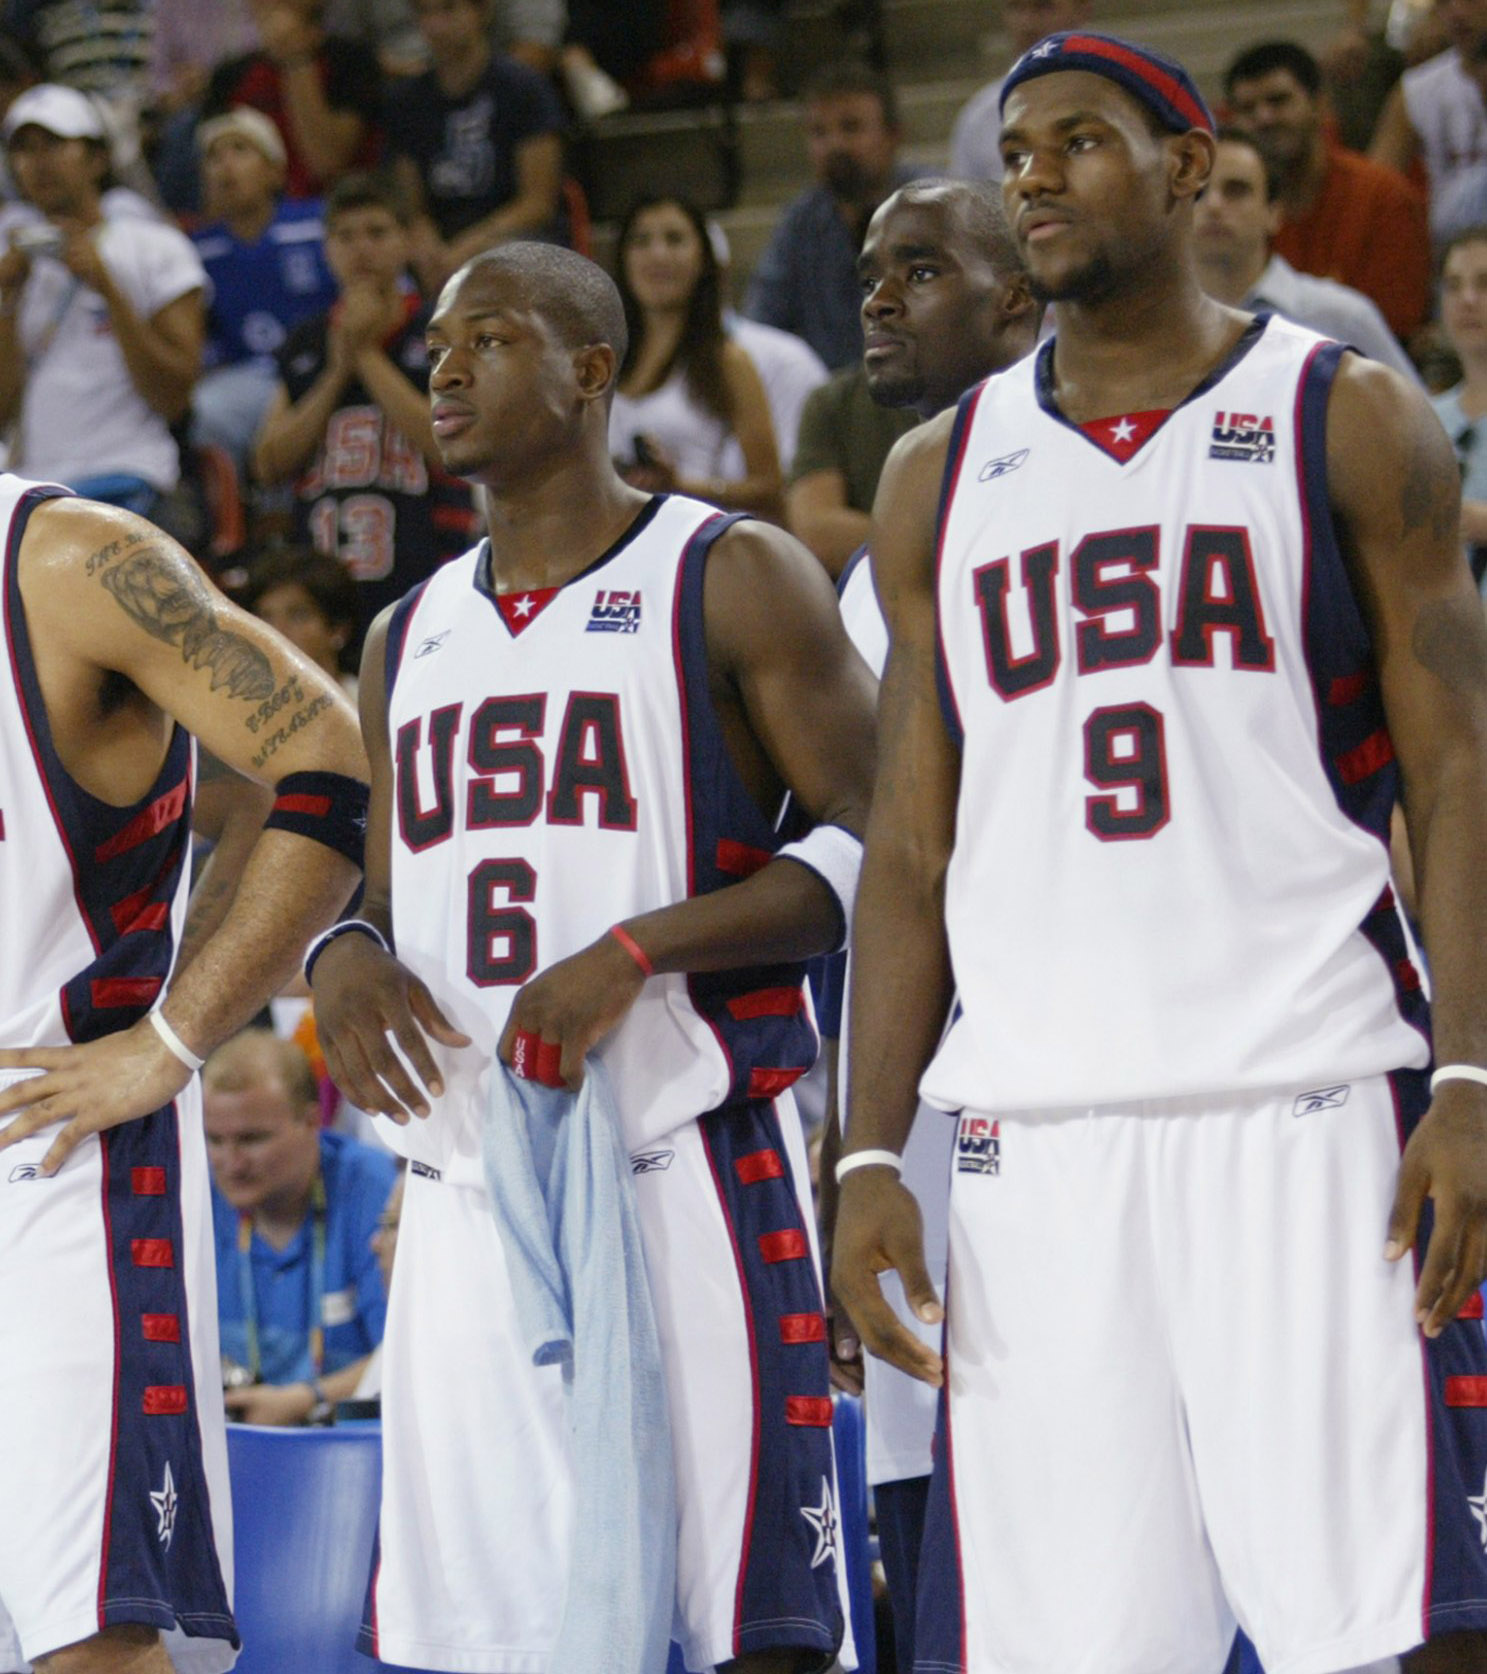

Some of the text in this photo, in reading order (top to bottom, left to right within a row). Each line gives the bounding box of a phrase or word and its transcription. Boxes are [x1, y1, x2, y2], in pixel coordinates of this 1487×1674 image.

[294, 405, 429, 497] SA
[1212, 411, 1275, 446] USA
[309, 494, 397, 580] 13
[591, 590, 641, 619] USA
[973, 523, 1276, 703] USA
[395, 690, 638, 854] USA
[1082, 701, 1171, 843] 9
[466, 857, 538, 989] 6
[959, 1118, 999, 1155] USA
